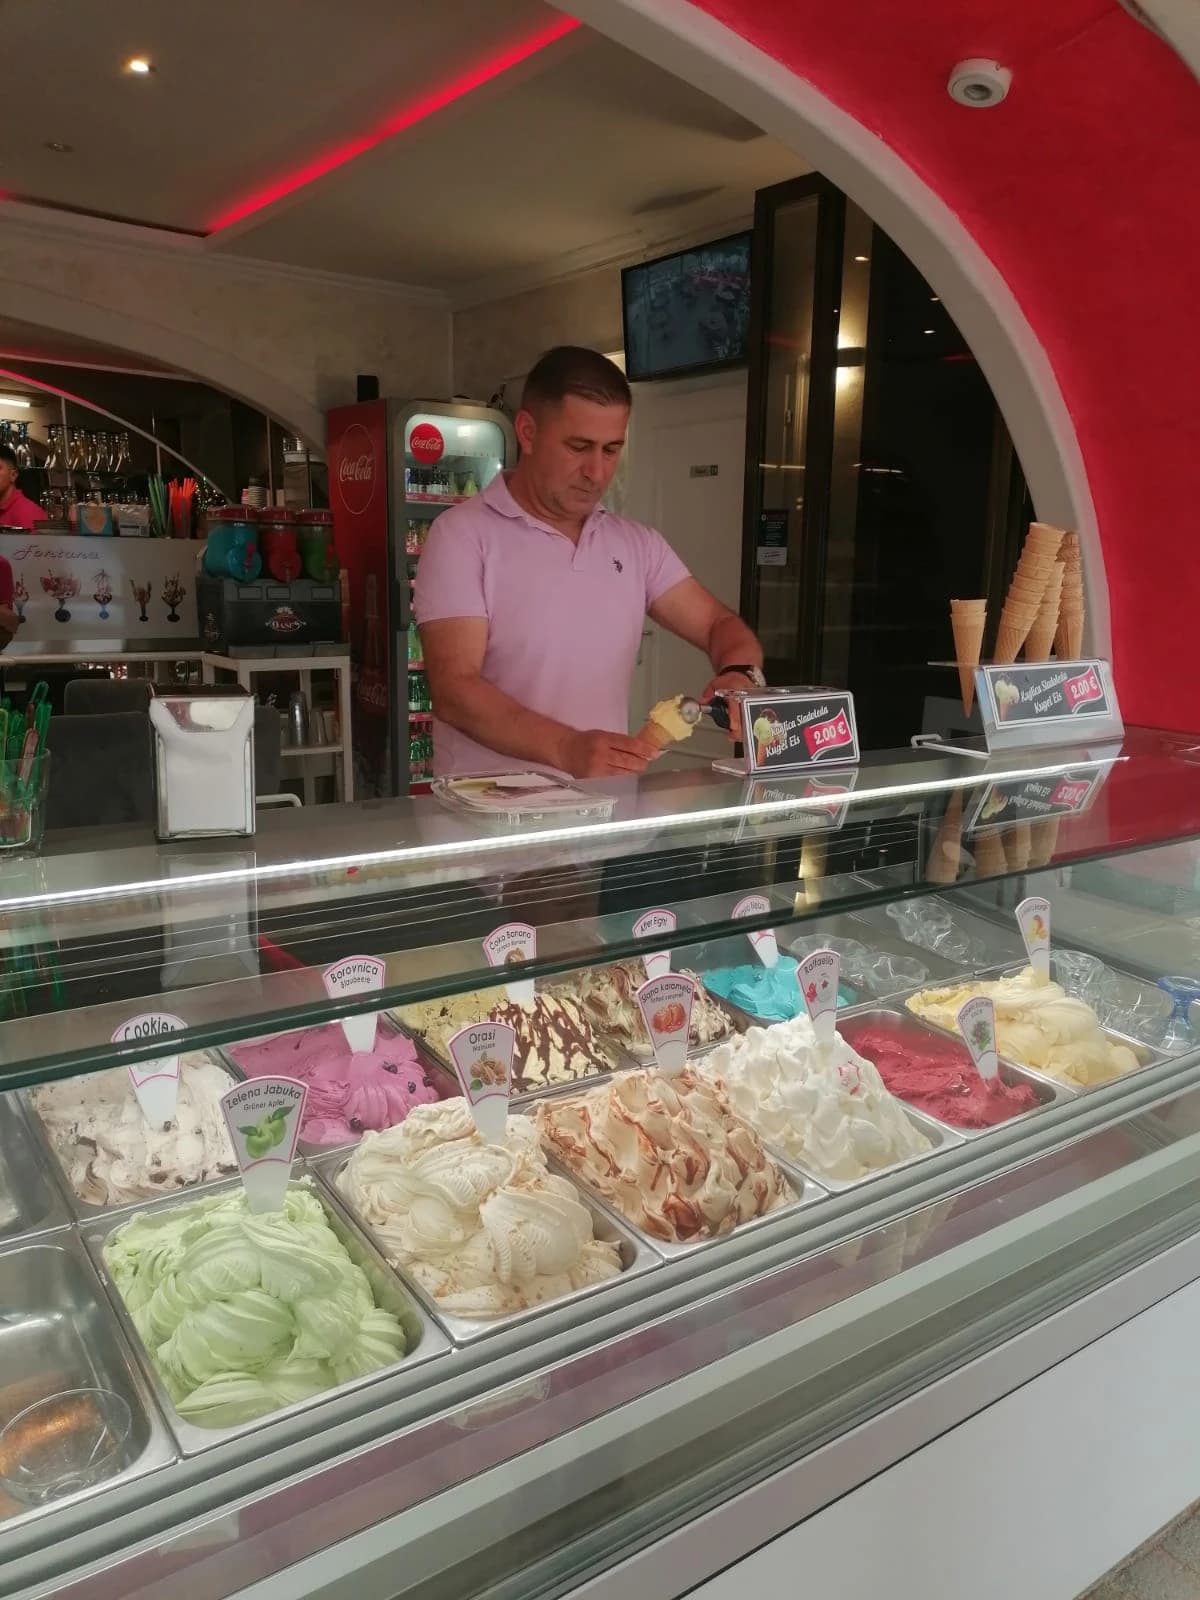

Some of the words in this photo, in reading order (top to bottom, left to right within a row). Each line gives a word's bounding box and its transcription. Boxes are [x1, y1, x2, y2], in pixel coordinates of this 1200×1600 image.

[1070, 682, 1090, 699] 2.00
[1089, 676, 1098, 690] €
[1033, 696, 1053, 714] Kugel
[1052, 692, 1062, 703] Eis
[770, 719, 797, 739] Kuglica
[796, 705, 829, 726] Sladoleda
[813, 725, 836, 745] 2.00
[837, 721, 847, 735] €
[765, 739, 789, 758] Kugel
[789, 734, 800, 747] Eis
[330, 961, 379, 983] Borovnica
[469, 1029, 496, 1044] Orasi
[225, 1088, 261, 1110] Zelena
[264, 1084, 302, 1100] Jabuka
